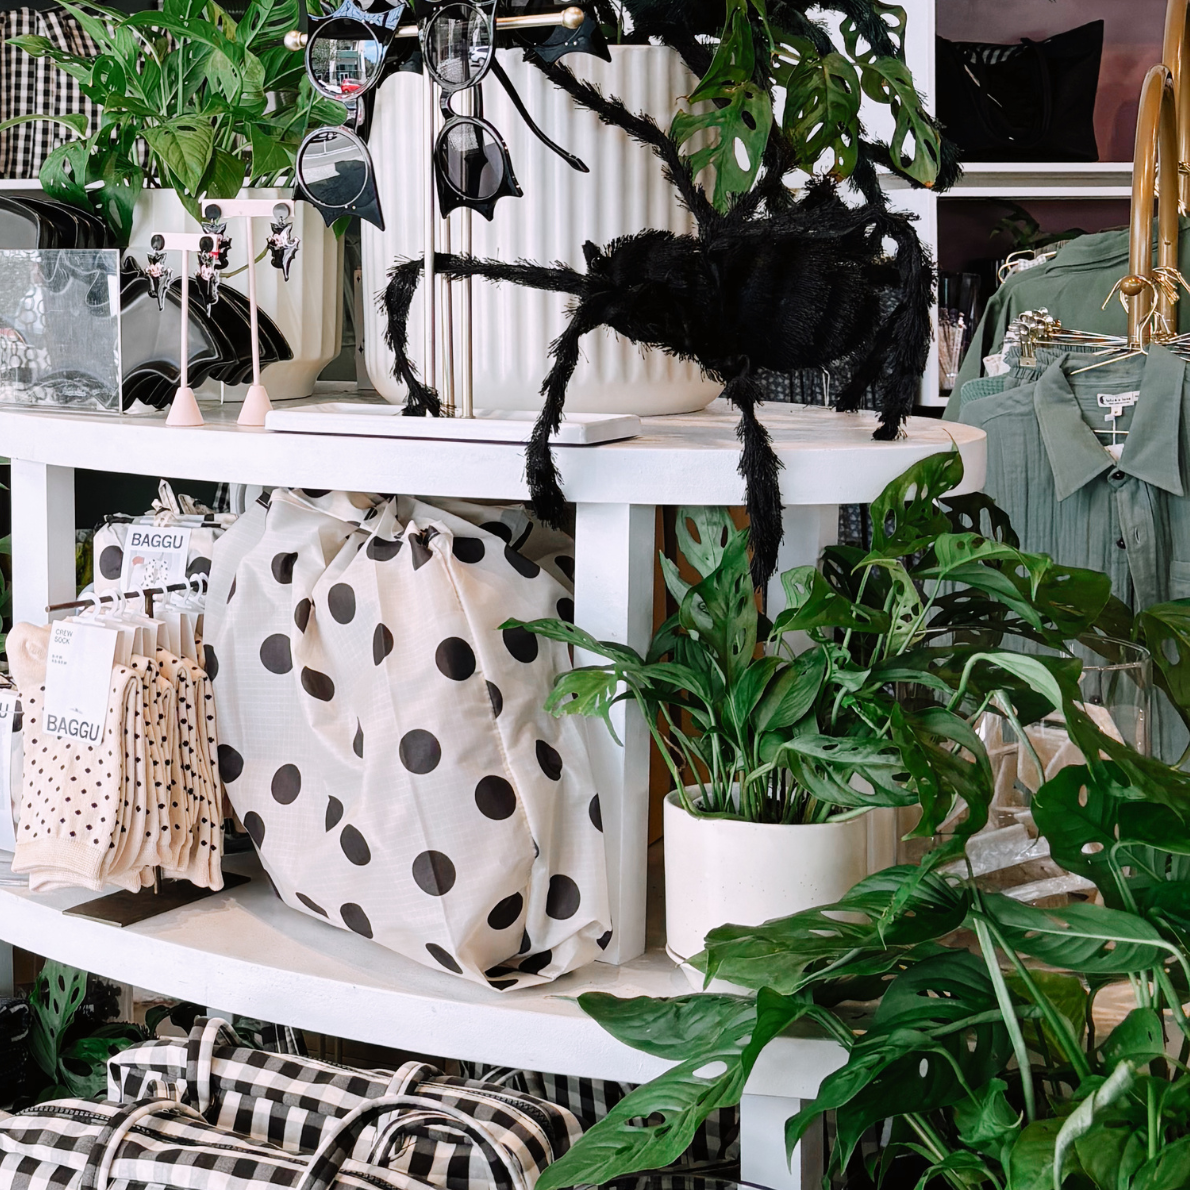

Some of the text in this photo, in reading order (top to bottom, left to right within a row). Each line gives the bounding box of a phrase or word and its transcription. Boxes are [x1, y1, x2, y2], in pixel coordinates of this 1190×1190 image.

[131, 532, 184, 549] BAGGU
[55, 628, 73, 637] CREW
[54, 635, 70, 644] SOCK
[46, 714, 100, 741] BAGGU
